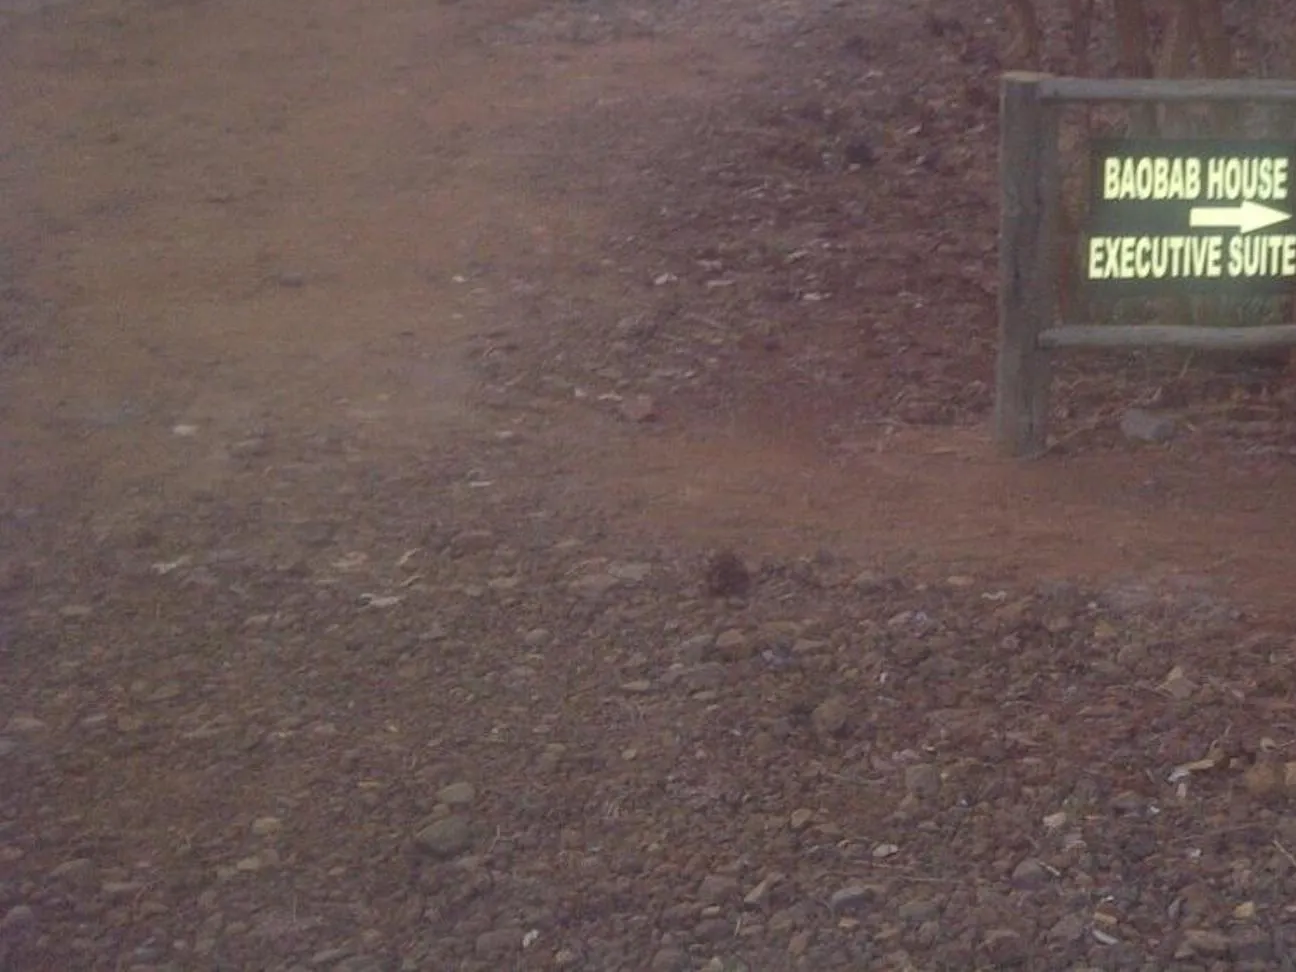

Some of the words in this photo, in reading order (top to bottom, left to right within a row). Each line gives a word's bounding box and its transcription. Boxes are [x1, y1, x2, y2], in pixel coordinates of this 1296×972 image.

[1103, 157, 1201, 199] BAOBAB
[1206, 157, 1289, 199] HOUSE
[1088, 235, 1223, 279] EXECUTIVE
